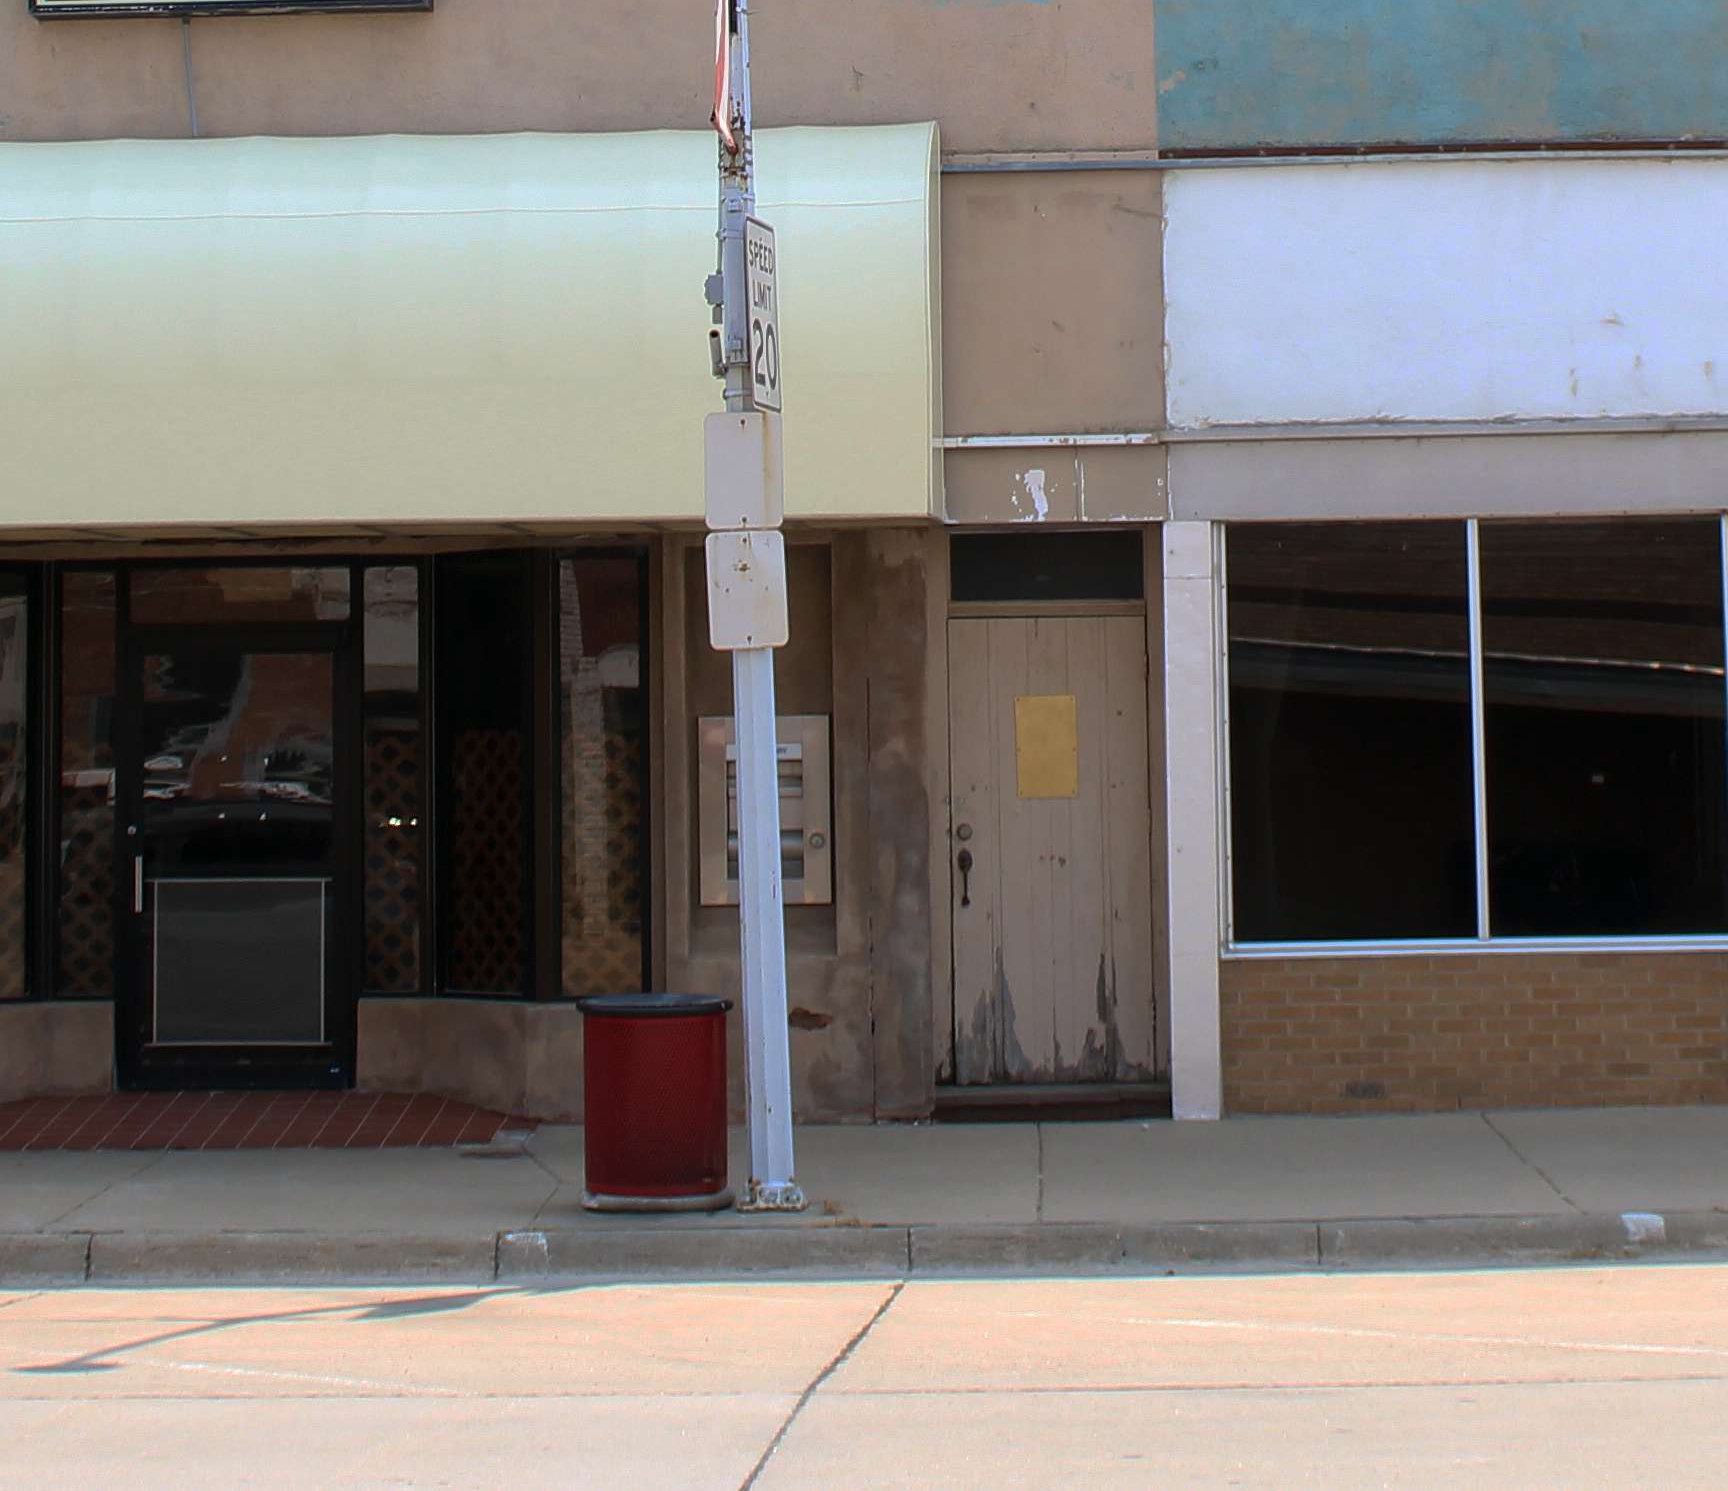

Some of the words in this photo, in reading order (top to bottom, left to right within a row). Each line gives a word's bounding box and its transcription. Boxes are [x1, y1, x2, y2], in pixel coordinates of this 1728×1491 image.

[748, 239, 774, 275] SPEED
[752, 279, 772, 311] LIMIT
[753, 317, 777, 391] 20
